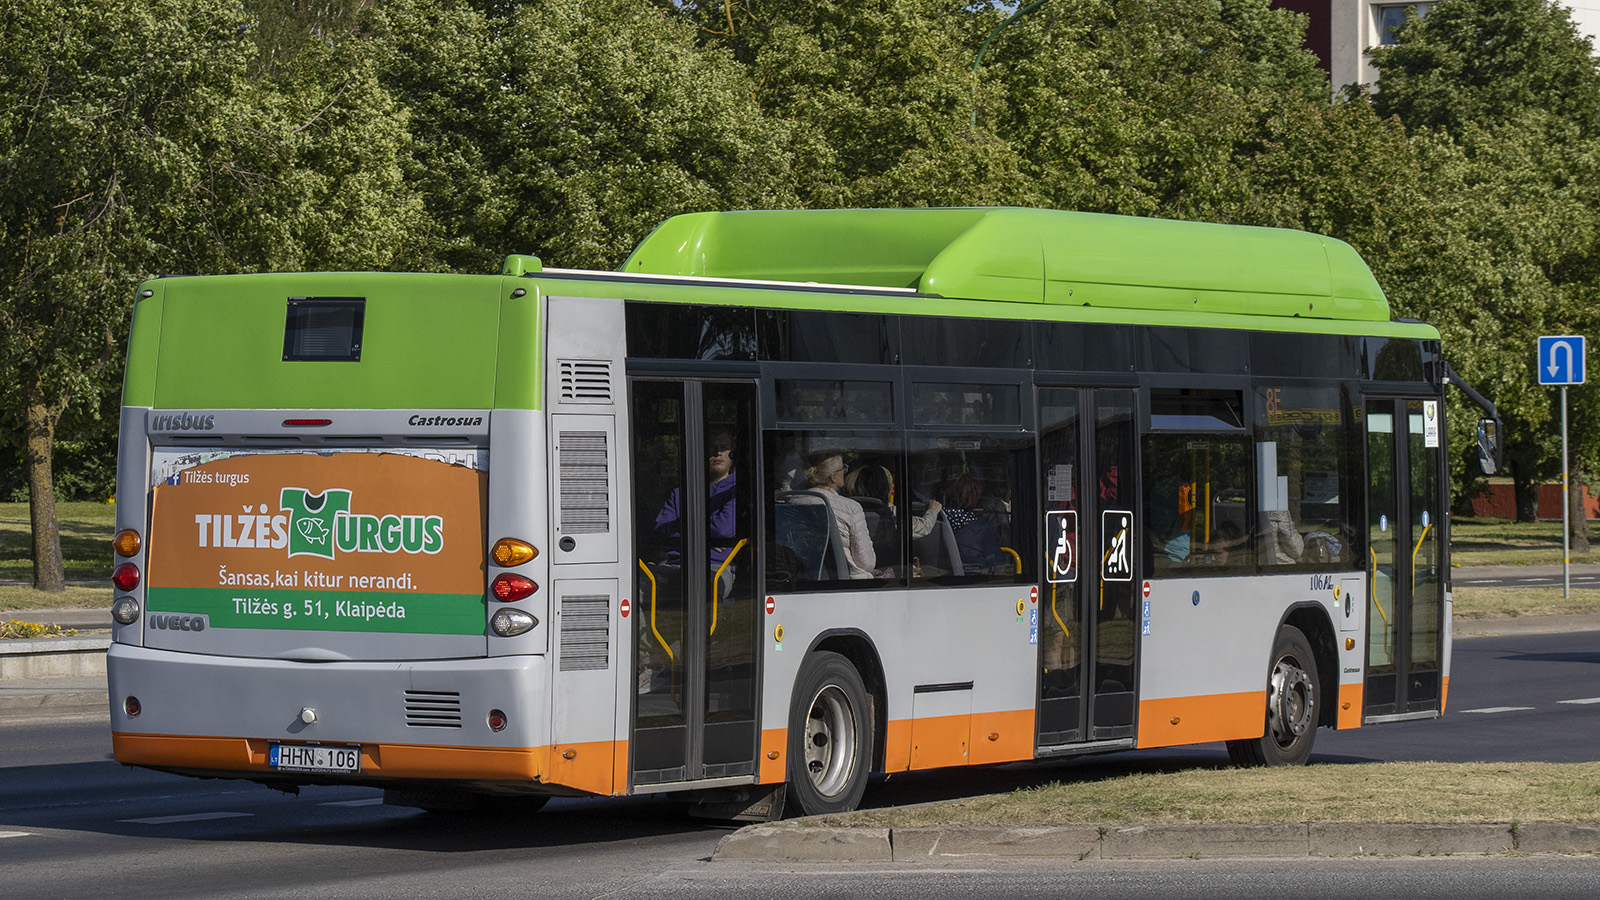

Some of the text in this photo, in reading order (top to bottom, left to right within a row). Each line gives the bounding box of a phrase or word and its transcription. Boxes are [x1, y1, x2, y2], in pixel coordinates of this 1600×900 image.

[1266, 388, 1282, 414] 8E
[408, 414, 483, 426] Castrosua
[184, 470, 250, 487] Tilžės turgus
[195, 503, 288, 549] TILŽĖS
[304, 571, 343, 587] kitur
[349, 573, 418, 590] nerandi.
[1310, 574, 1323, 590] 106
[232, 598, 406, 621] Tilžės g. 51, Klaipėda
[150, 615, 205, 632] IVECO
[280, 747, 356, 768] HHN 106
